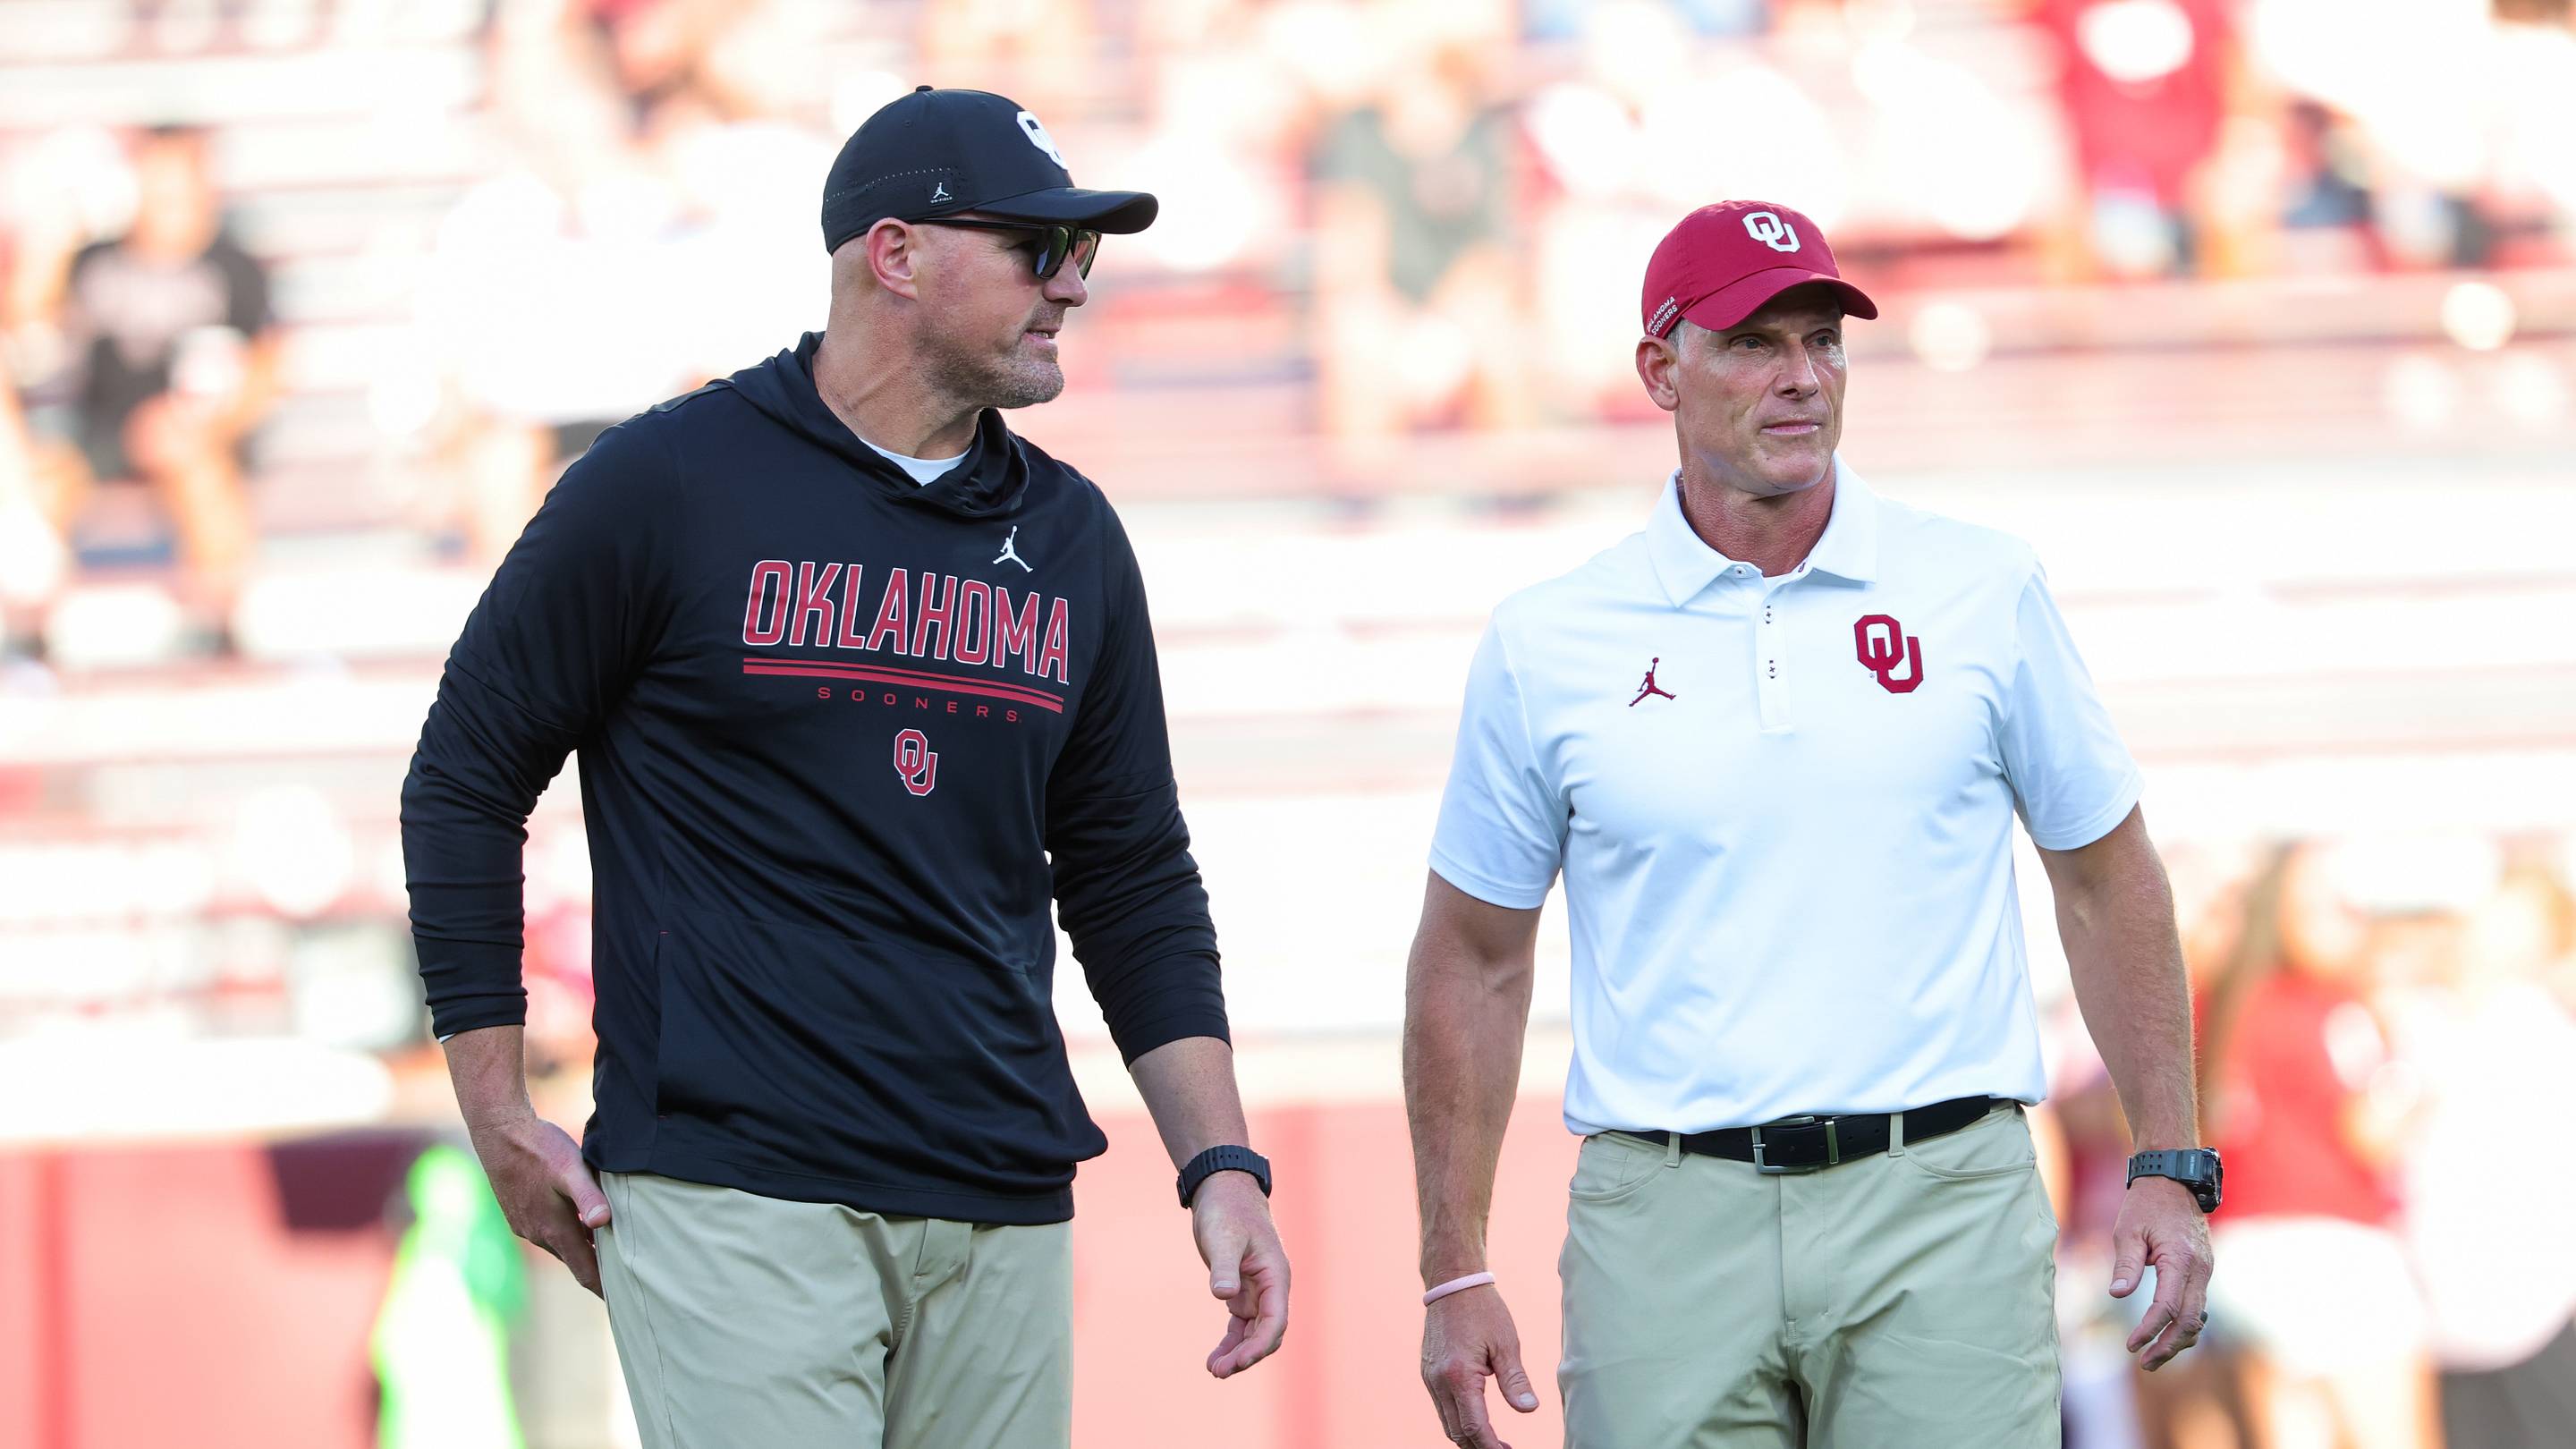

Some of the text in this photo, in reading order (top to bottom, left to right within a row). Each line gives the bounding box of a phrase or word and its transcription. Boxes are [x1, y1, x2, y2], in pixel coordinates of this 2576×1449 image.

[1742, 211, 1801, 253] OU
[1651, 304, 1678, 335] SOONERS
[742, 560, 1069, 684] OKLAHOMA
[1854, 614, 1924, 693] OU
[818, 686, 1017, 722] SOONERS
[894, 728, 938, 796] OU
